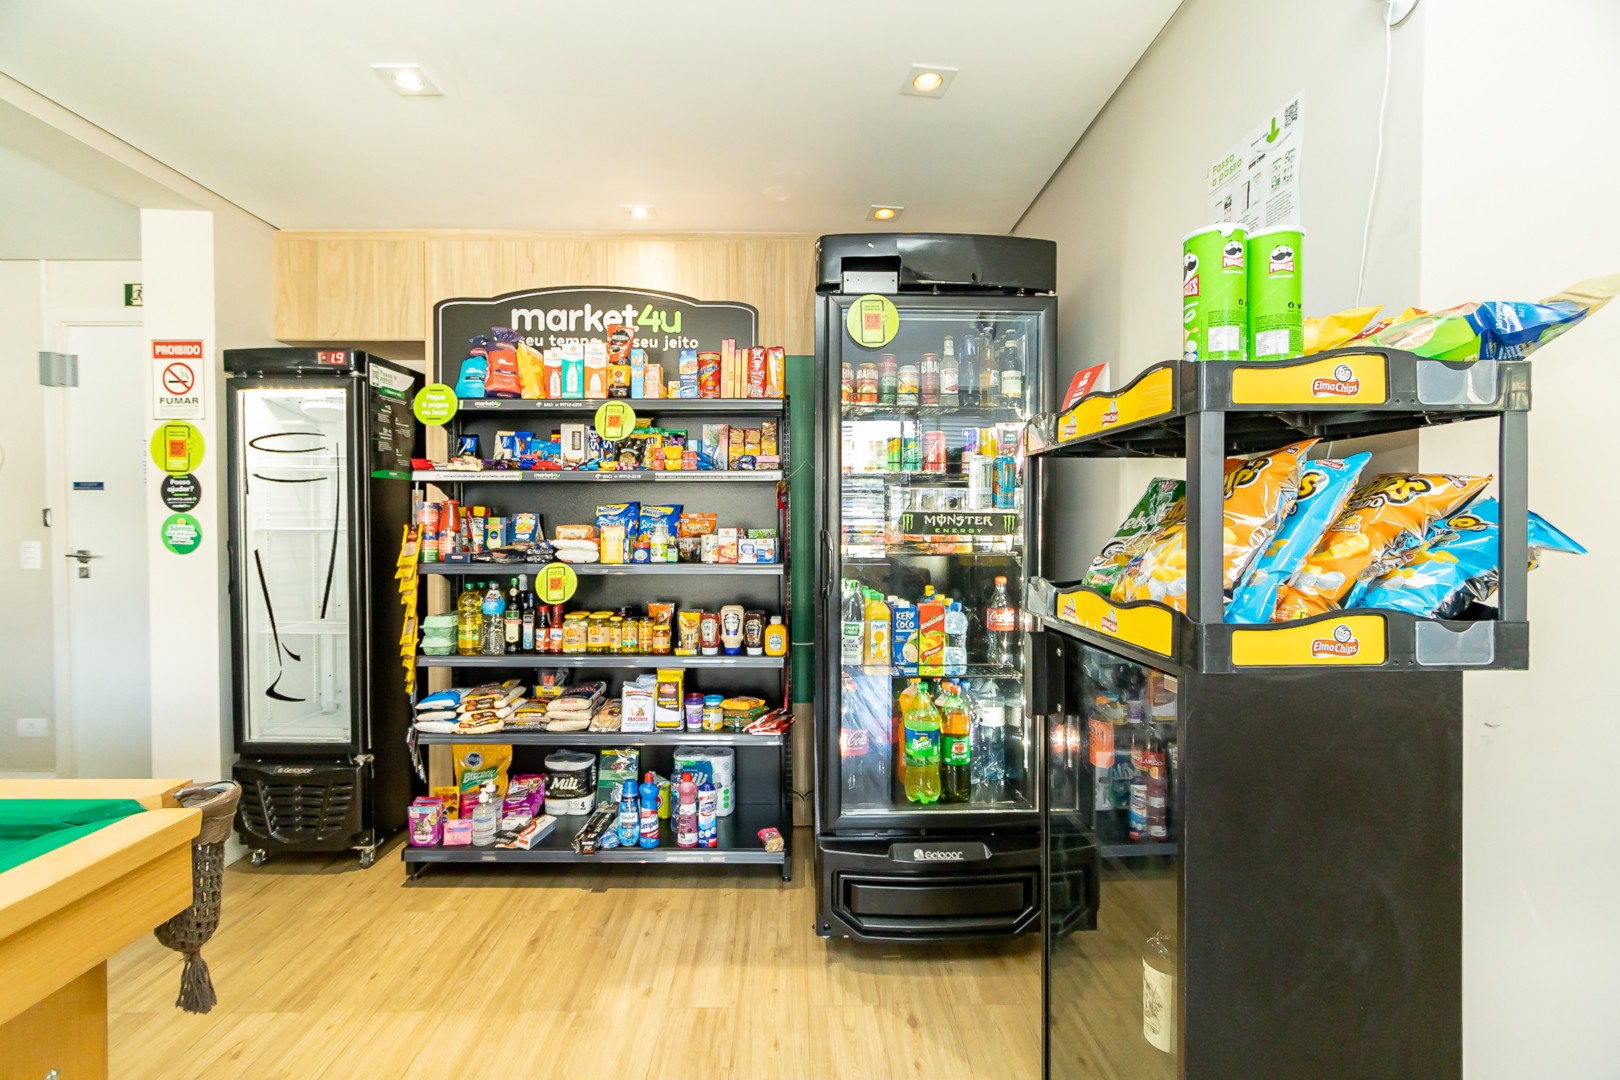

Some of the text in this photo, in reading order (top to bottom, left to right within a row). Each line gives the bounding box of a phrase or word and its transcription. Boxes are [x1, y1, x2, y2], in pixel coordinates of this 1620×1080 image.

[511, 303, 682, 333] market4u
[633, 337, 658, 348] seu
[663, 335, 699, 351] jeito
[154, 345, 201, 356] PROIBIDO
[159, 397, 200, 405] FUMAR
[924, 514, 993, 530] MONSTER
[550, 777, 578, 790] Mili
[925, 851, 963, 859] Gelopar
